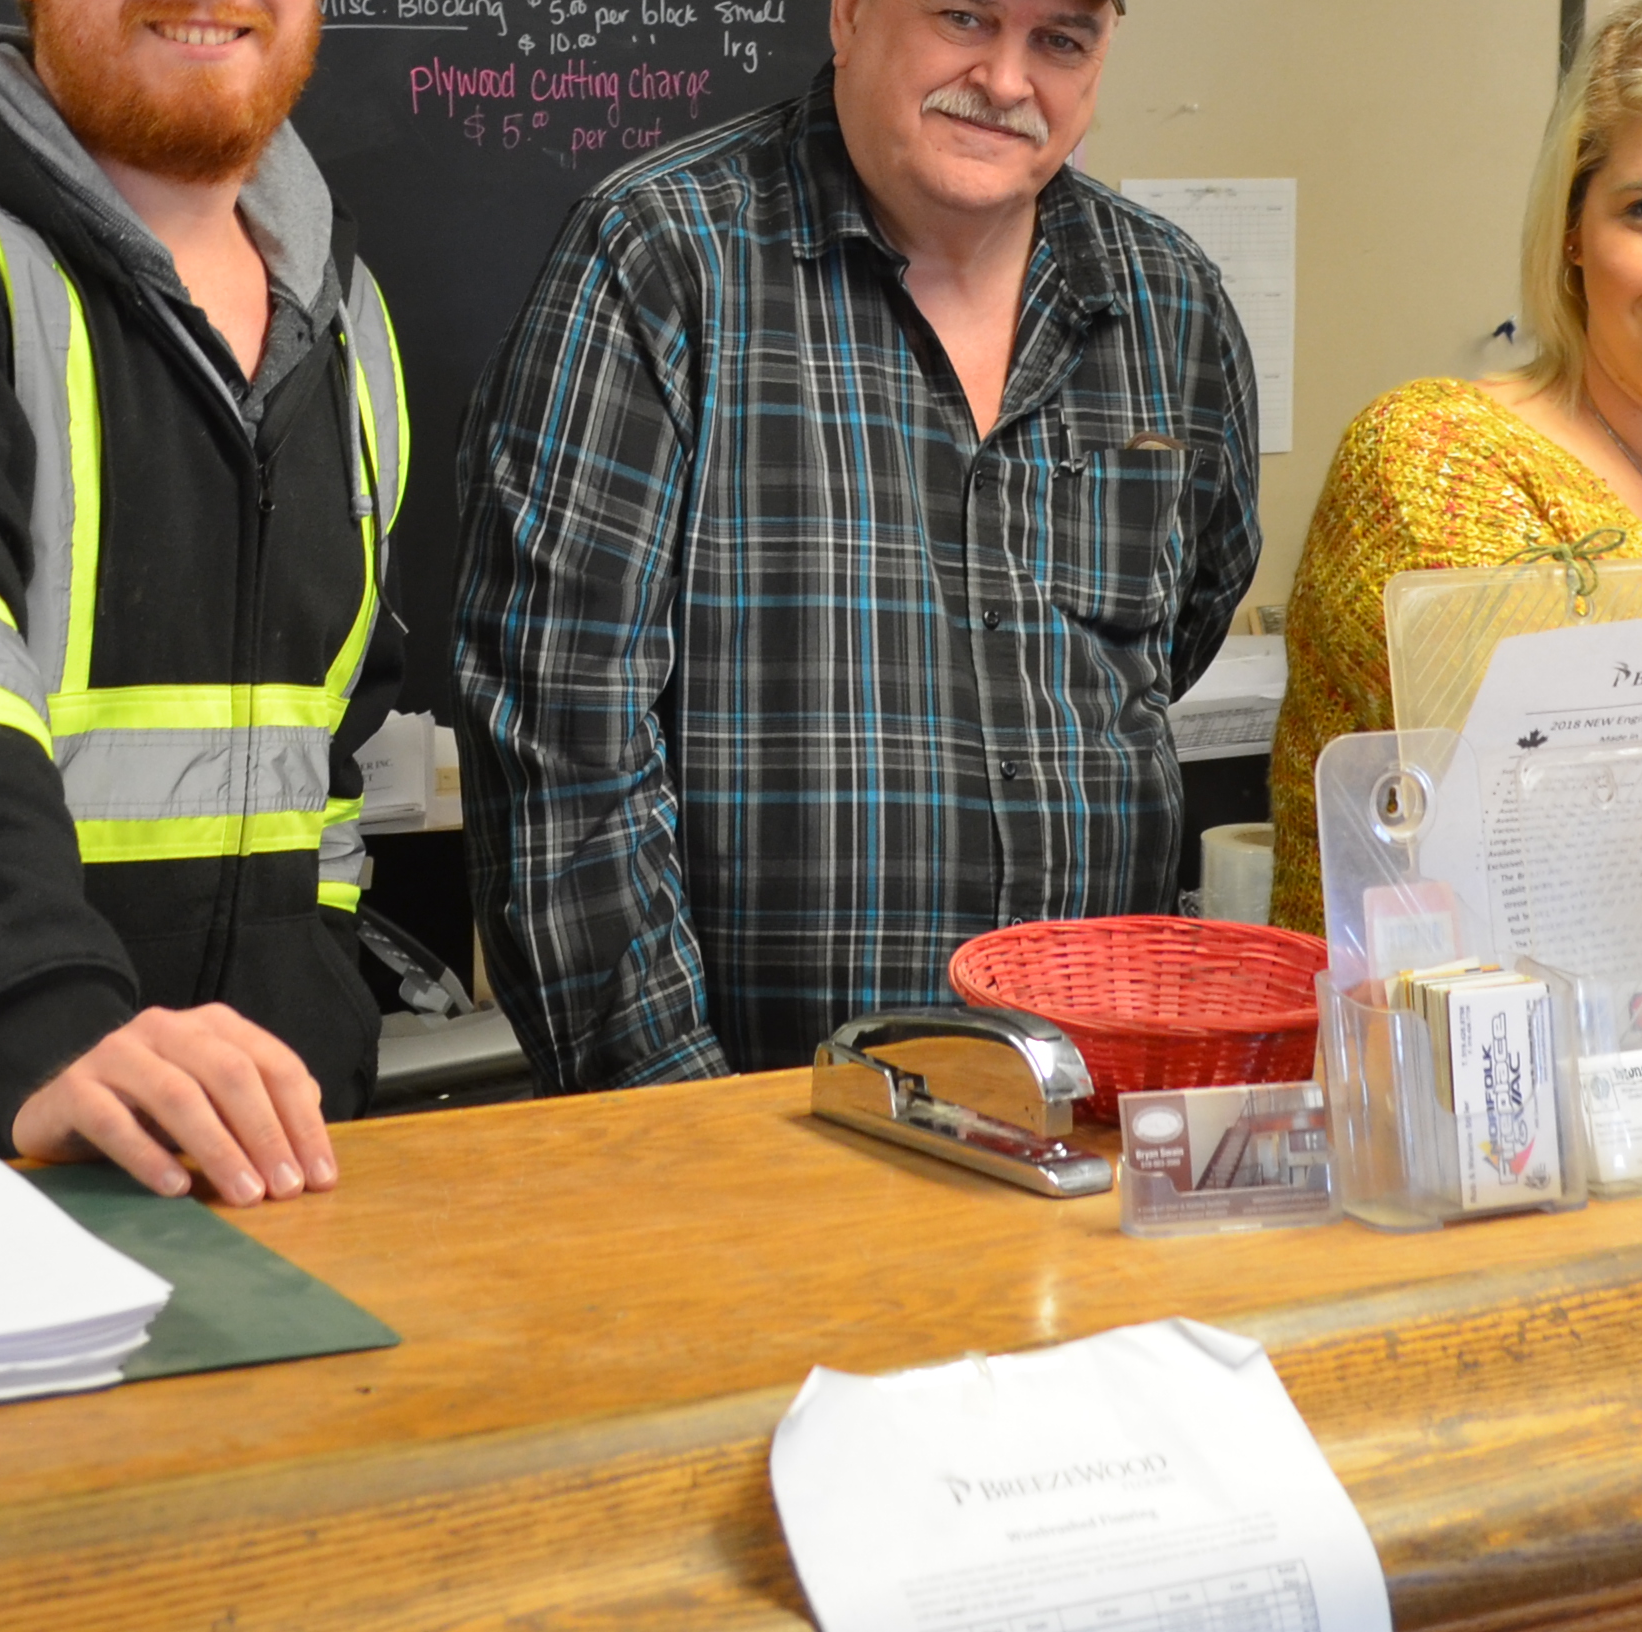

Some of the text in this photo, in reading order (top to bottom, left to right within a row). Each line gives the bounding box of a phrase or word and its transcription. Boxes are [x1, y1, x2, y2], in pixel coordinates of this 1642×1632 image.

[594, 3, 631, 34] per
[409, 56, 711, 127] plywood cutting charge
[572, 125, 607, 153] per
[1550, 719, 1581, 731] 2018
[1583, 716, 1615, 729] NEW
